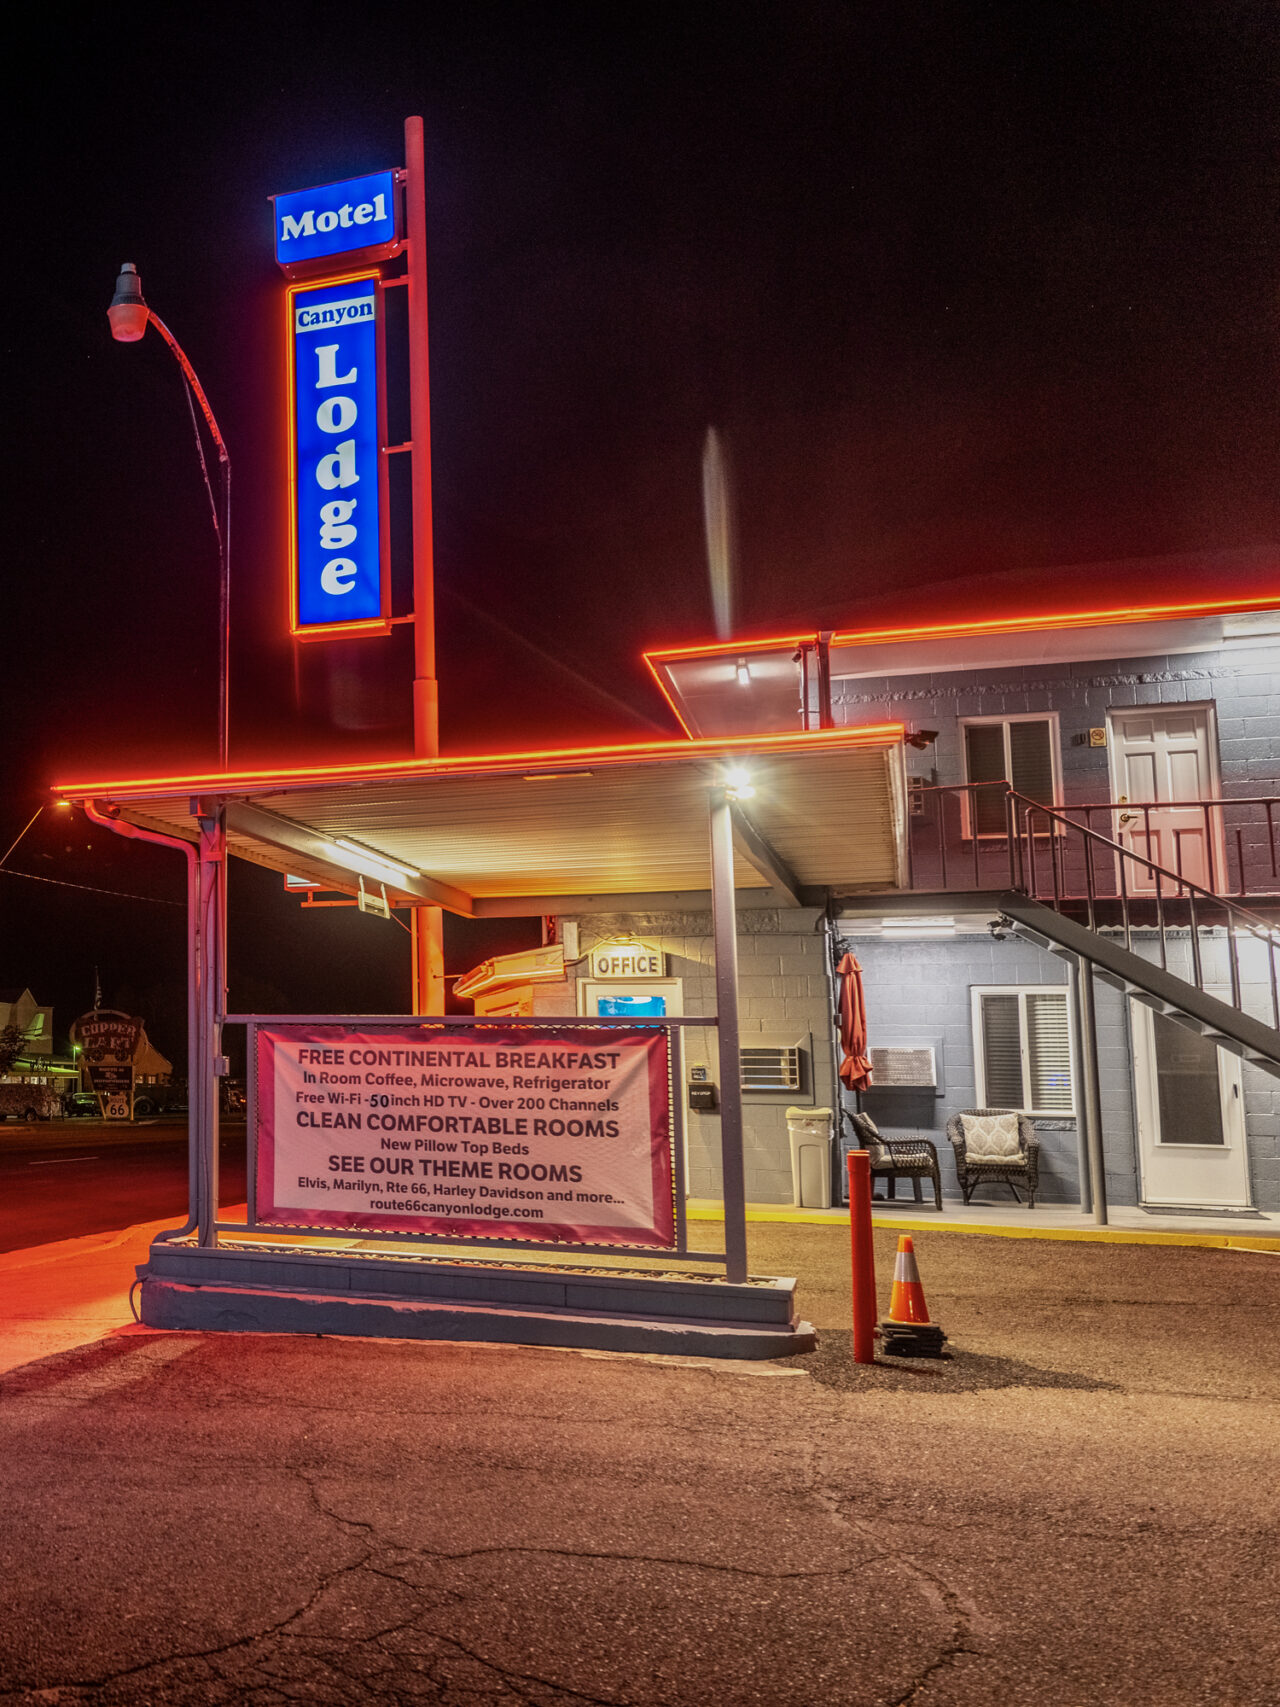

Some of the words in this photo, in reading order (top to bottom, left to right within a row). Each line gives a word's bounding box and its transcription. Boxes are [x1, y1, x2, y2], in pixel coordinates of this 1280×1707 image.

[281, 193, 388, 242] Motel
[297, 301, 375, 329] Canyon
[314, 343, 360, 595] Lodge
[597, 956, 657, 974] OFFICE
[81, 1023, 136, 1035] COPPER
[298, 1049, 345, 1065] FREE
[349, 1050, 491, 1067] CONTINENTAL
[495, 1051, 621, 1069] BREAKFAST
[303, 1071, 316, 1084] In
[319, 1072, 361, 1085] Room
[365, 1072, 417, 1088] Coffee,
[420, 1073, 509, 1091] Microwave,
[513, 1075, 611, 1093] Refrigerator
[110, 1104, 125, 1116] 66
[296, 1091, 325, 1104] Free
[328, 1092, 361, 1105] Wi-Fi
[423, 1095, 445, 1107] HD
[448, 1096, 467, 1107] TV
[479, 1096, 514, 1110] Over
[517, 1097, 545, 1110] 200
[549, 1098, 619, 1112] Channels
[296, 1111, 362, 1130] CLEAN
[366, 1113, 528, 1135] COMFORTABLE
[533, 1118, 620, 1138] ROOMS
[380, 1138, 411, 1150] New
[414, 1139, 458, 1153] Pillow
[461, 1141, 489, 1156] Top
[492, 1142, 530, 1156] Beds
[328, 1155, 365, 1173] SEE
[370, 1157, 414, 1176] OUR
[418, 1159, 493, 1179] THEME
[498, 1162, 583, 1183] ROOMS
[298, 1176, 330, 1191] Elvis,
[333, 1178, 384, 1194] Marilyn,
[386, 1181, 408, 1194] Rte
[411, 1183, 431, 1197] 66,
[433, 1184, 476, 1199] Harley
[479, 1185, 544, 1200] Davidson
[546, 1190, 573, 1202] and
[576, 1191, 625, 1204] more...
[370, 1200, 544, 1219] route66canyonlodge.com
